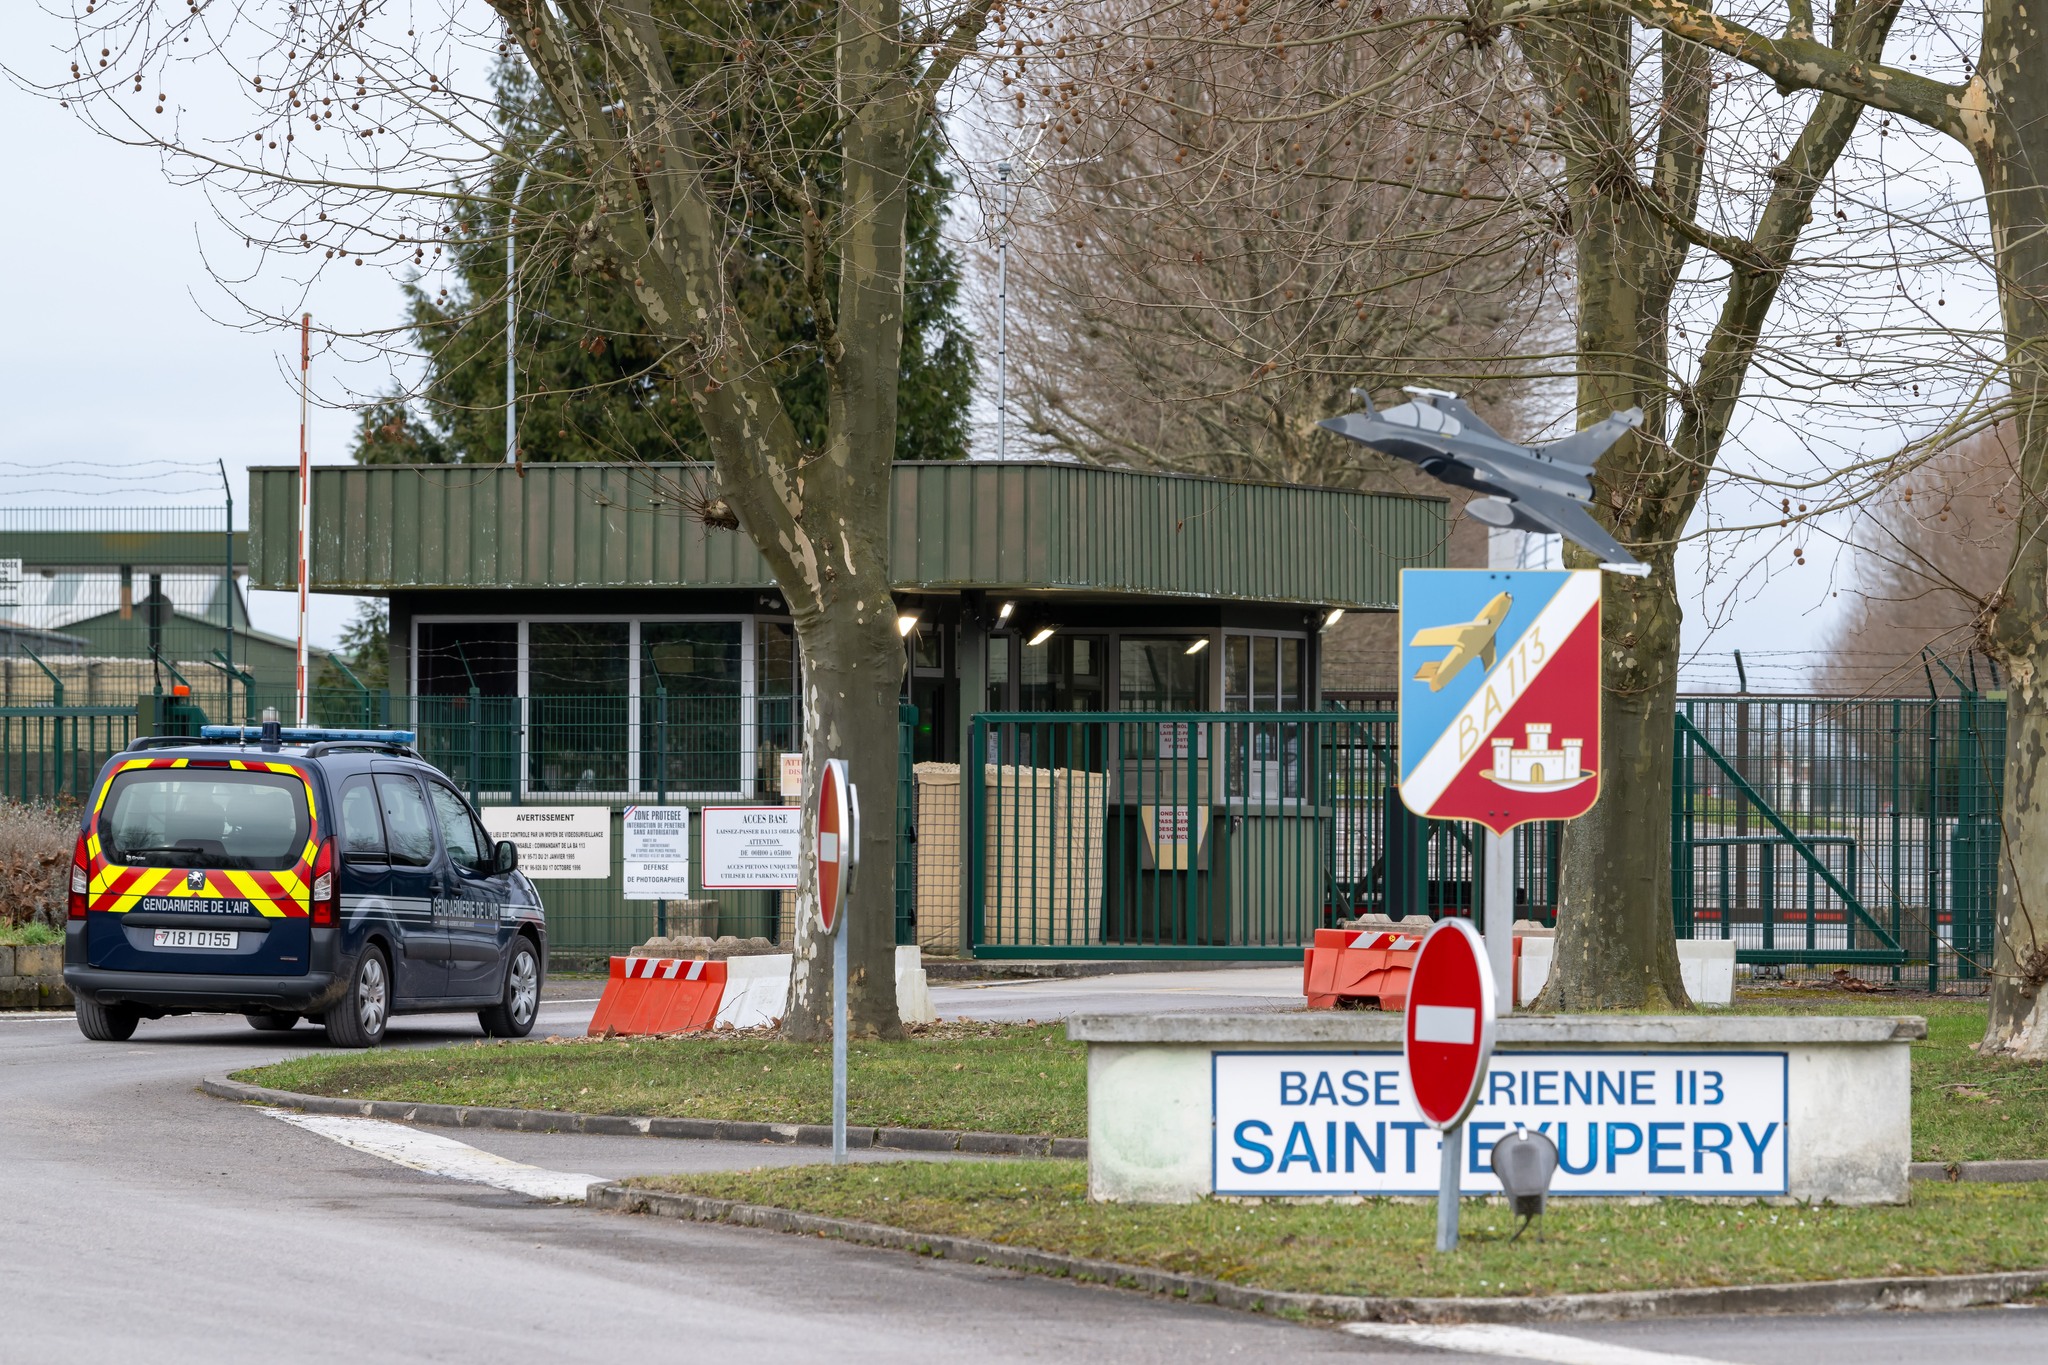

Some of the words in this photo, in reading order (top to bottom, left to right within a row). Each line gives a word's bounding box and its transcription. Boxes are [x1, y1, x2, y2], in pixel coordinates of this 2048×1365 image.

[634, 810, 649, 820] ZONE
[652, 810, 681, 820] PROTEGEE
[742, 814, 766, 824] ACCES
[768, 814, 788, 824] BASE
[142, 898, 208, 913] GENDARMERIE
[211, 900, 224, 913] DE
[225, 900, 249, 914] L'AIR
[433, 898, 475, 918] GENDARMERIE
[476, 901, 484, 918] DE
[485, 902, 498, 920] L'AIR
[162, 931, 192, 945] 7181
[197, 932, 231, 946] 0155
[1280, 1070, 1399, 1106] BASE
[1476, 1071, 1656, 1106] RIENNE
[1675, 1071, 1724, 1106] 113
